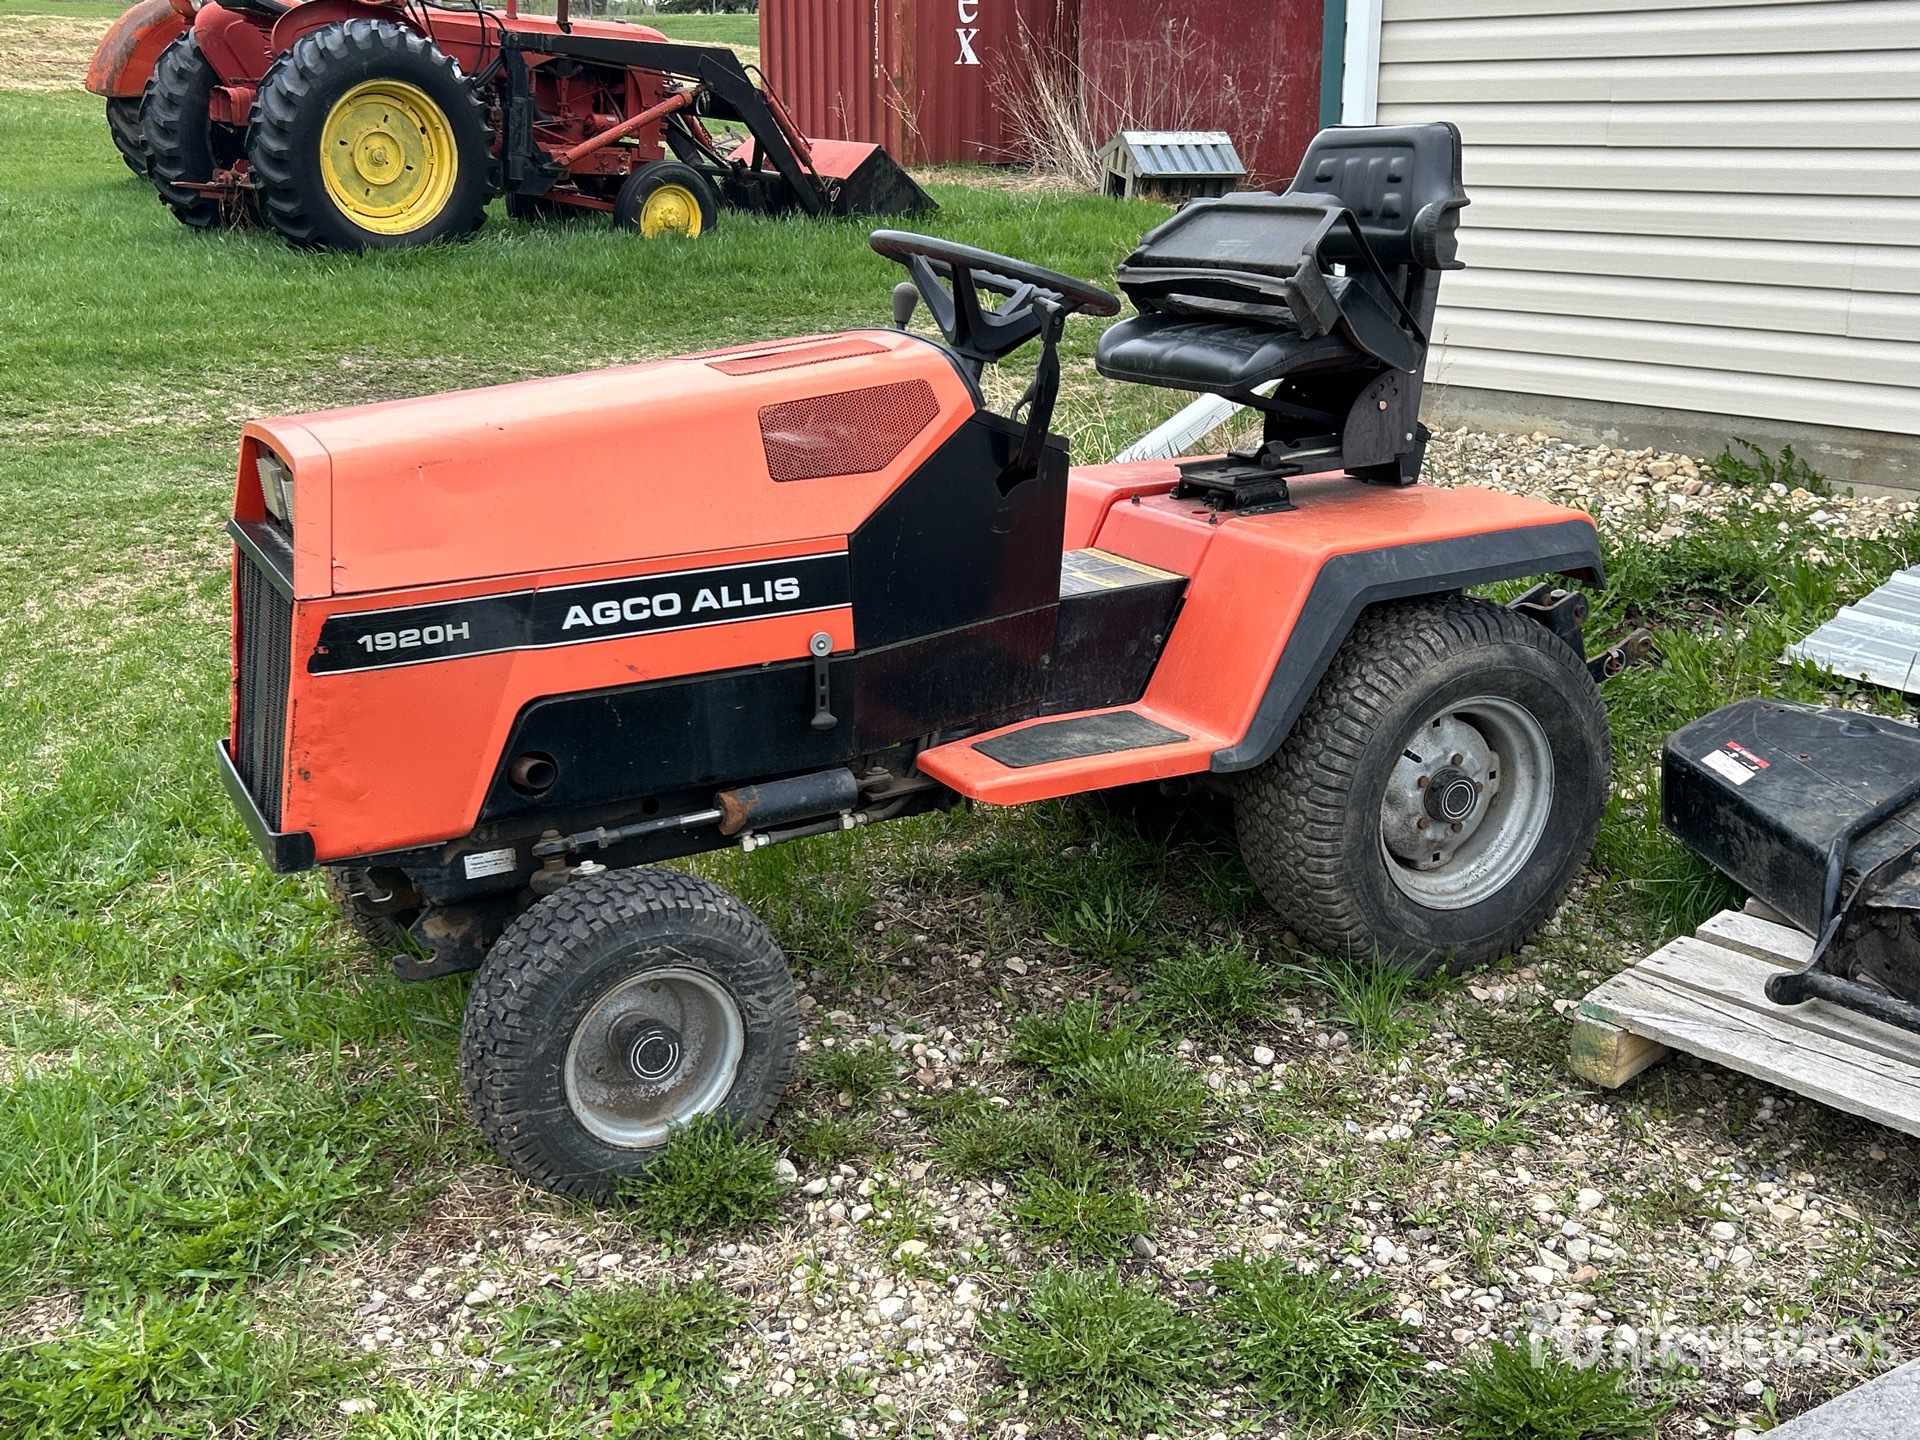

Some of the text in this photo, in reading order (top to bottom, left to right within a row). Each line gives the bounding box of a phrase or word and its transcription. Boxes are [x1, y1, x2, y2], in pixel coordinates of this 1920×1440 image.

[562, 577, 801, 631] AGCO ALLIS
[356, 621, 471, 654] 1920H
